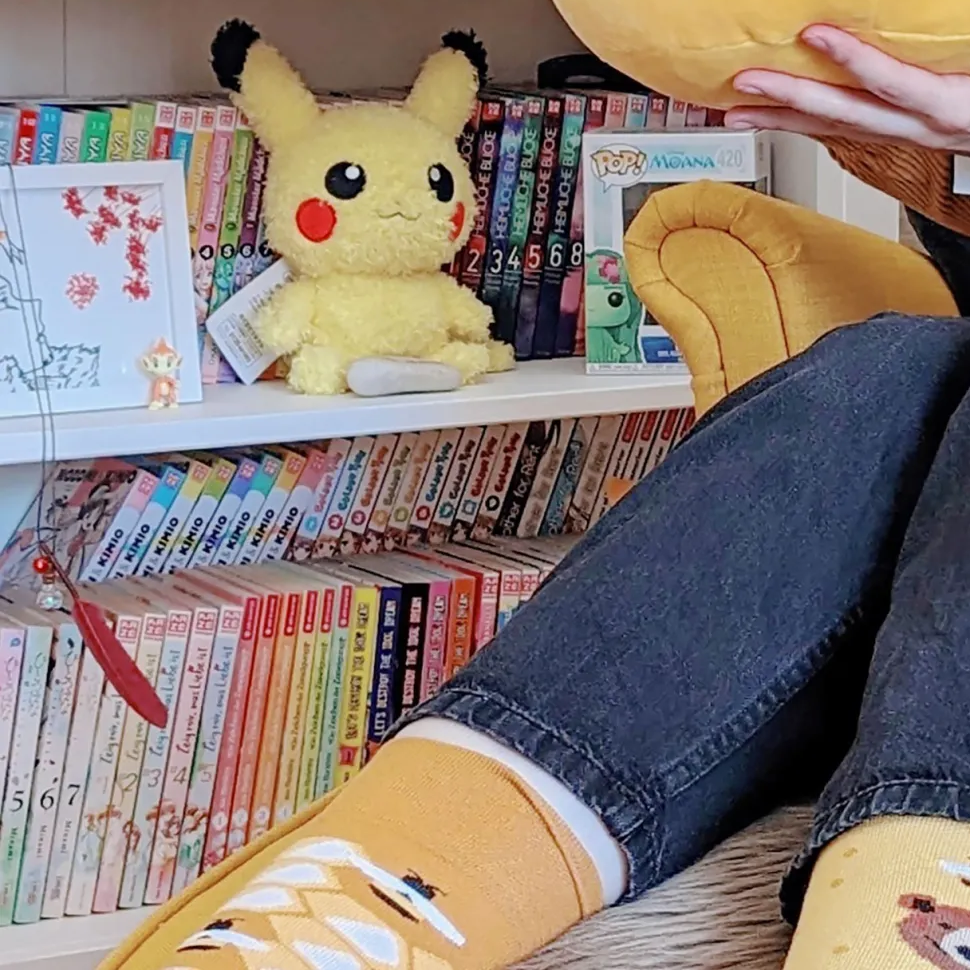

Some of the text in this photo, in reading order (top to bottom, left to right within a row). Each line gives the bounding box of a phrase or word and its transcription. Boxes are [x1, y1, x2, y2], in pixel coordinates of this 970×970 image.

[590, 149, 647, 177] POP!
[467, 249, 480, 273] 2
[490, 249, 503, 274] 3
[507, 246, 521, 270] 4
[528, 245, 541, 269] 5
[550, 243, 563, 268] 6
[571, 243, 583, 266] 8
[153, 517, 179, 556] KIMIO
[179, 517, 204, 556] KIMIO
[203, 515, 228, 554] KIMIO
[226, 511, 251, 550] KIMIO
[250, 508, 275, 548] KIMIO
[274, 505, 299, 546] KIMIO
[97, 528, 125, 567] KIMIO
[125, 524, 151, 562] KIMIO
[384, 599, 397, 627] DREAM
[380, 653, 391, 670] THE
[406, 649, 418, 666] THE
[376, 673, 389, 709] DESTROY
[173, 766, 188, 784] 4
[9, 790, 25, 813] 5
[40, 787, 55, 811] 6
[67, 783, 81, 806] 7
